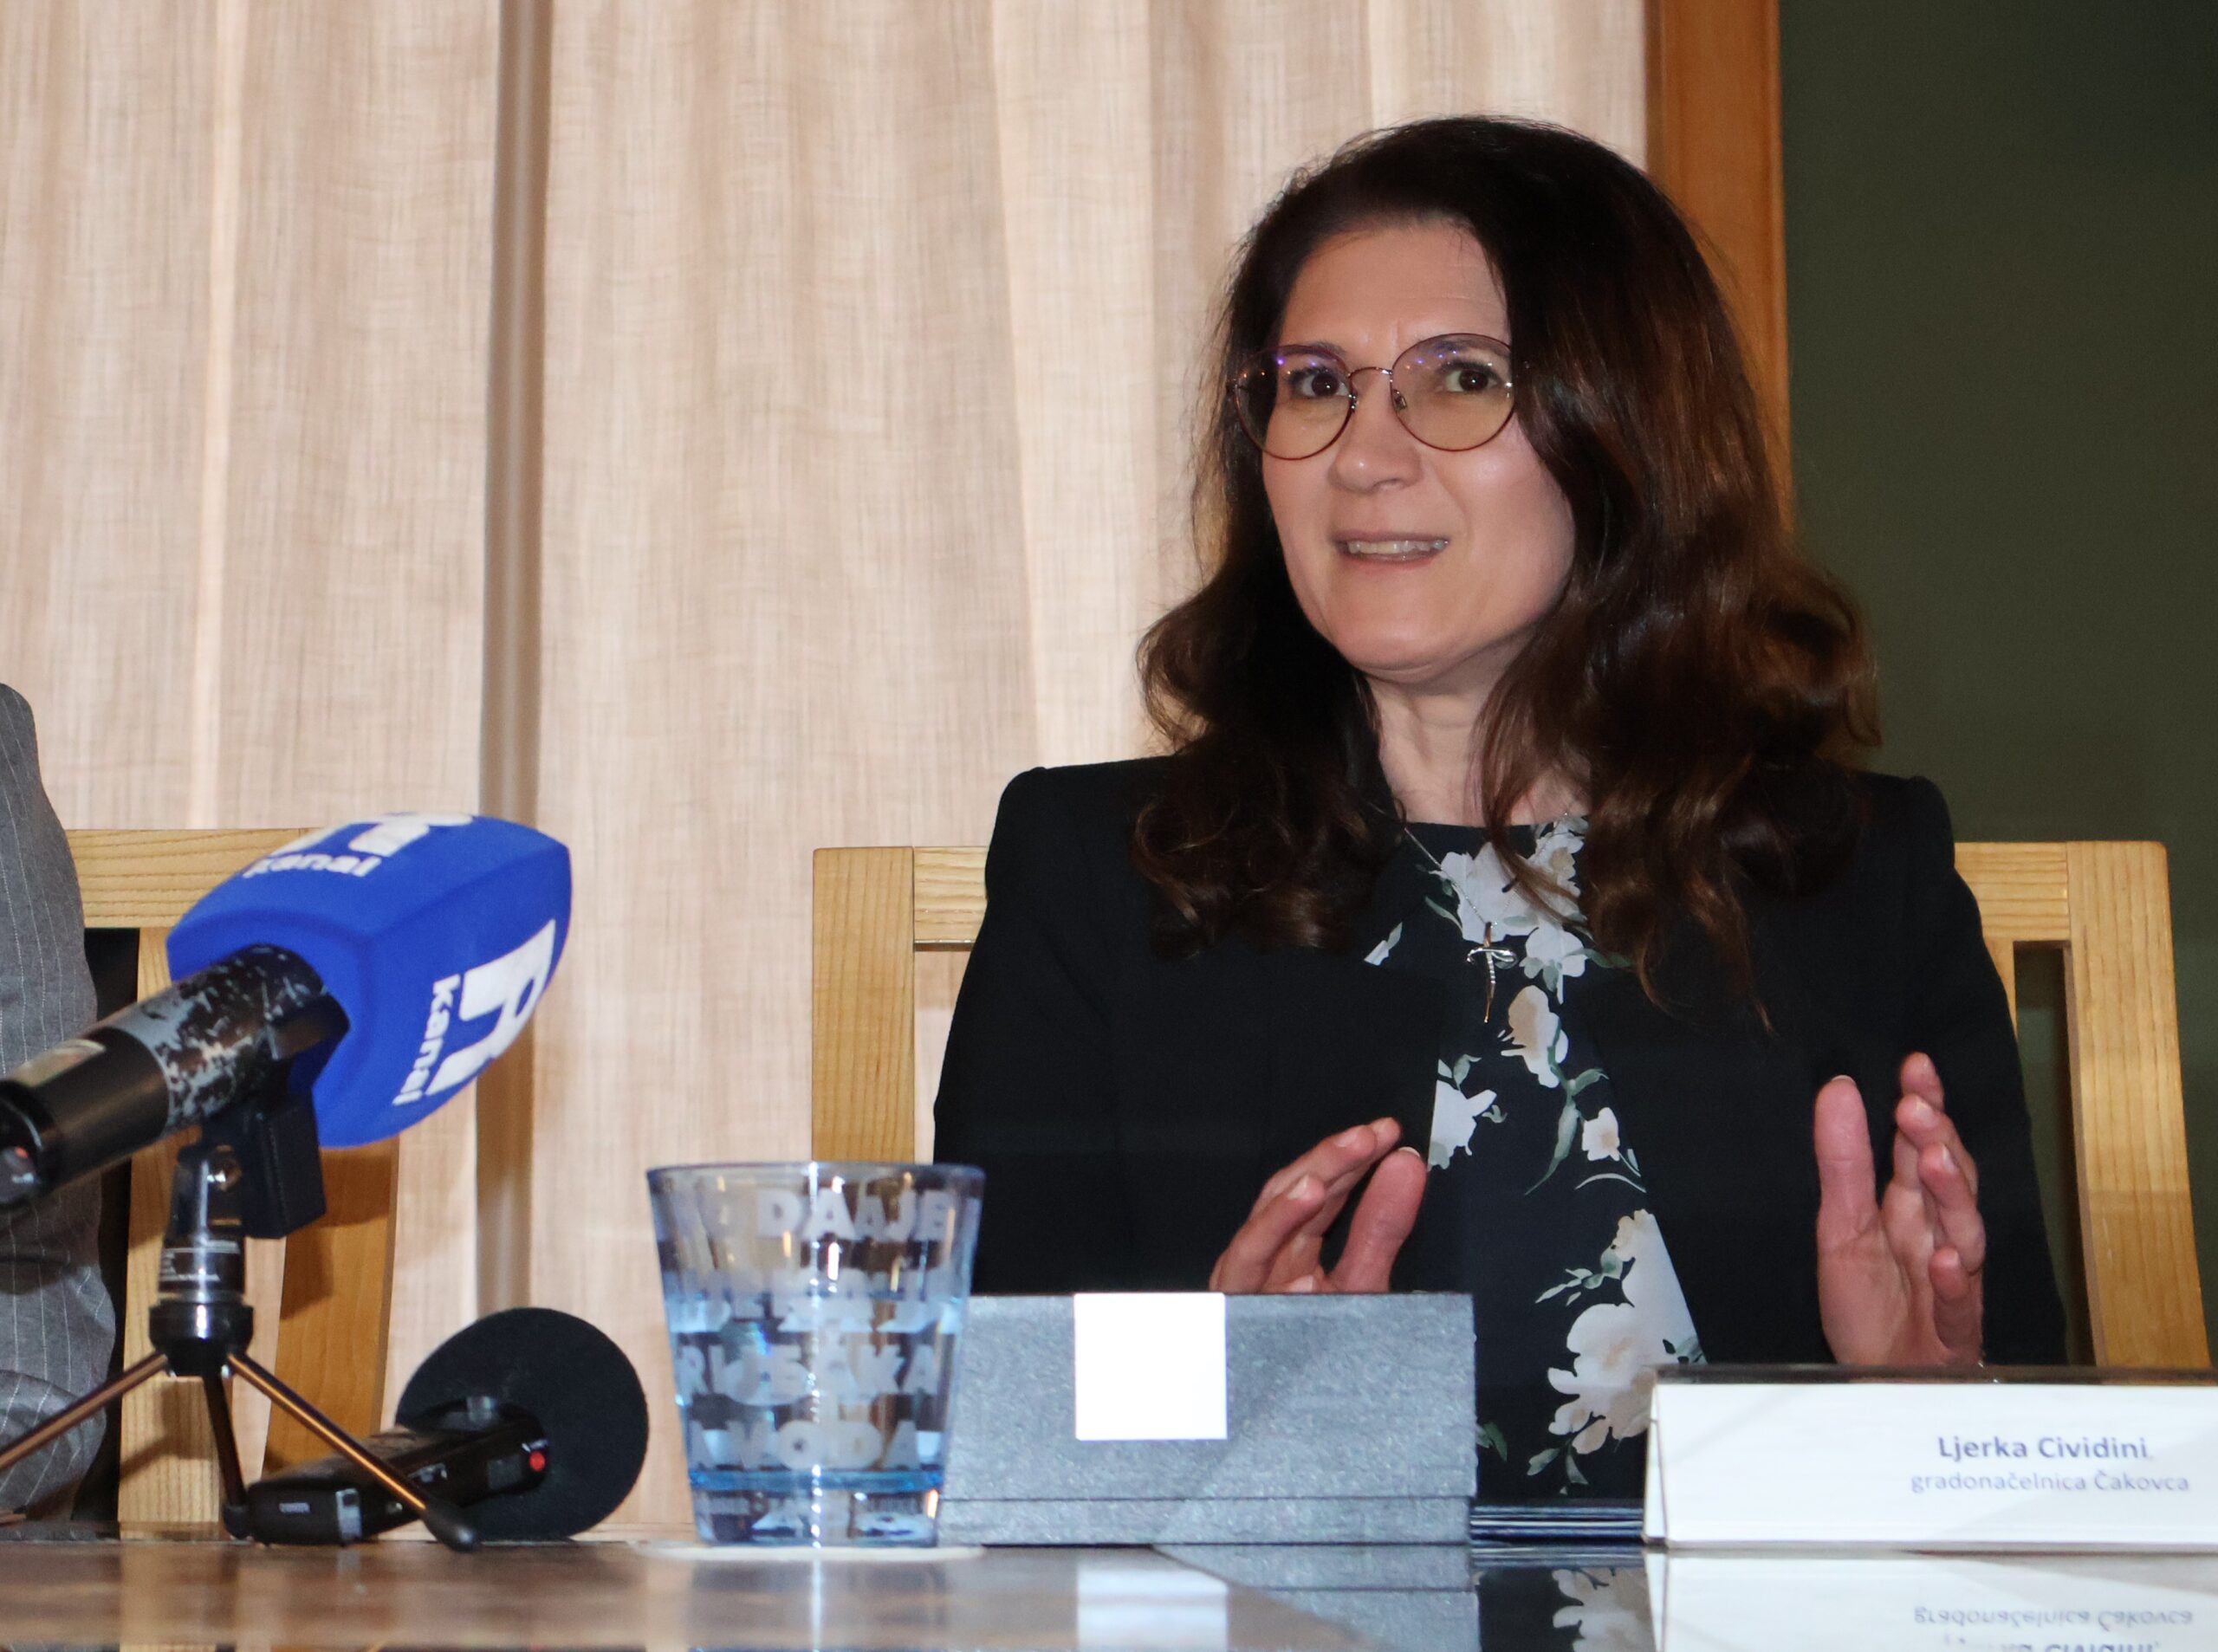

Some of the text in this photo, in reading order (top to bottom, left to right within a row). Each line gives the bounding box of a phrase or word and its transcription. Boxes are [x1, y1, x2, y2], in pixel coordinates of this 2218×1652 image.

[392, 974, 461, 1106] kanal
[1937, 1435, 2028, 1462] Ljerka
[1910, 1469, 2189, 1493] gradonačelnica Čakovca
